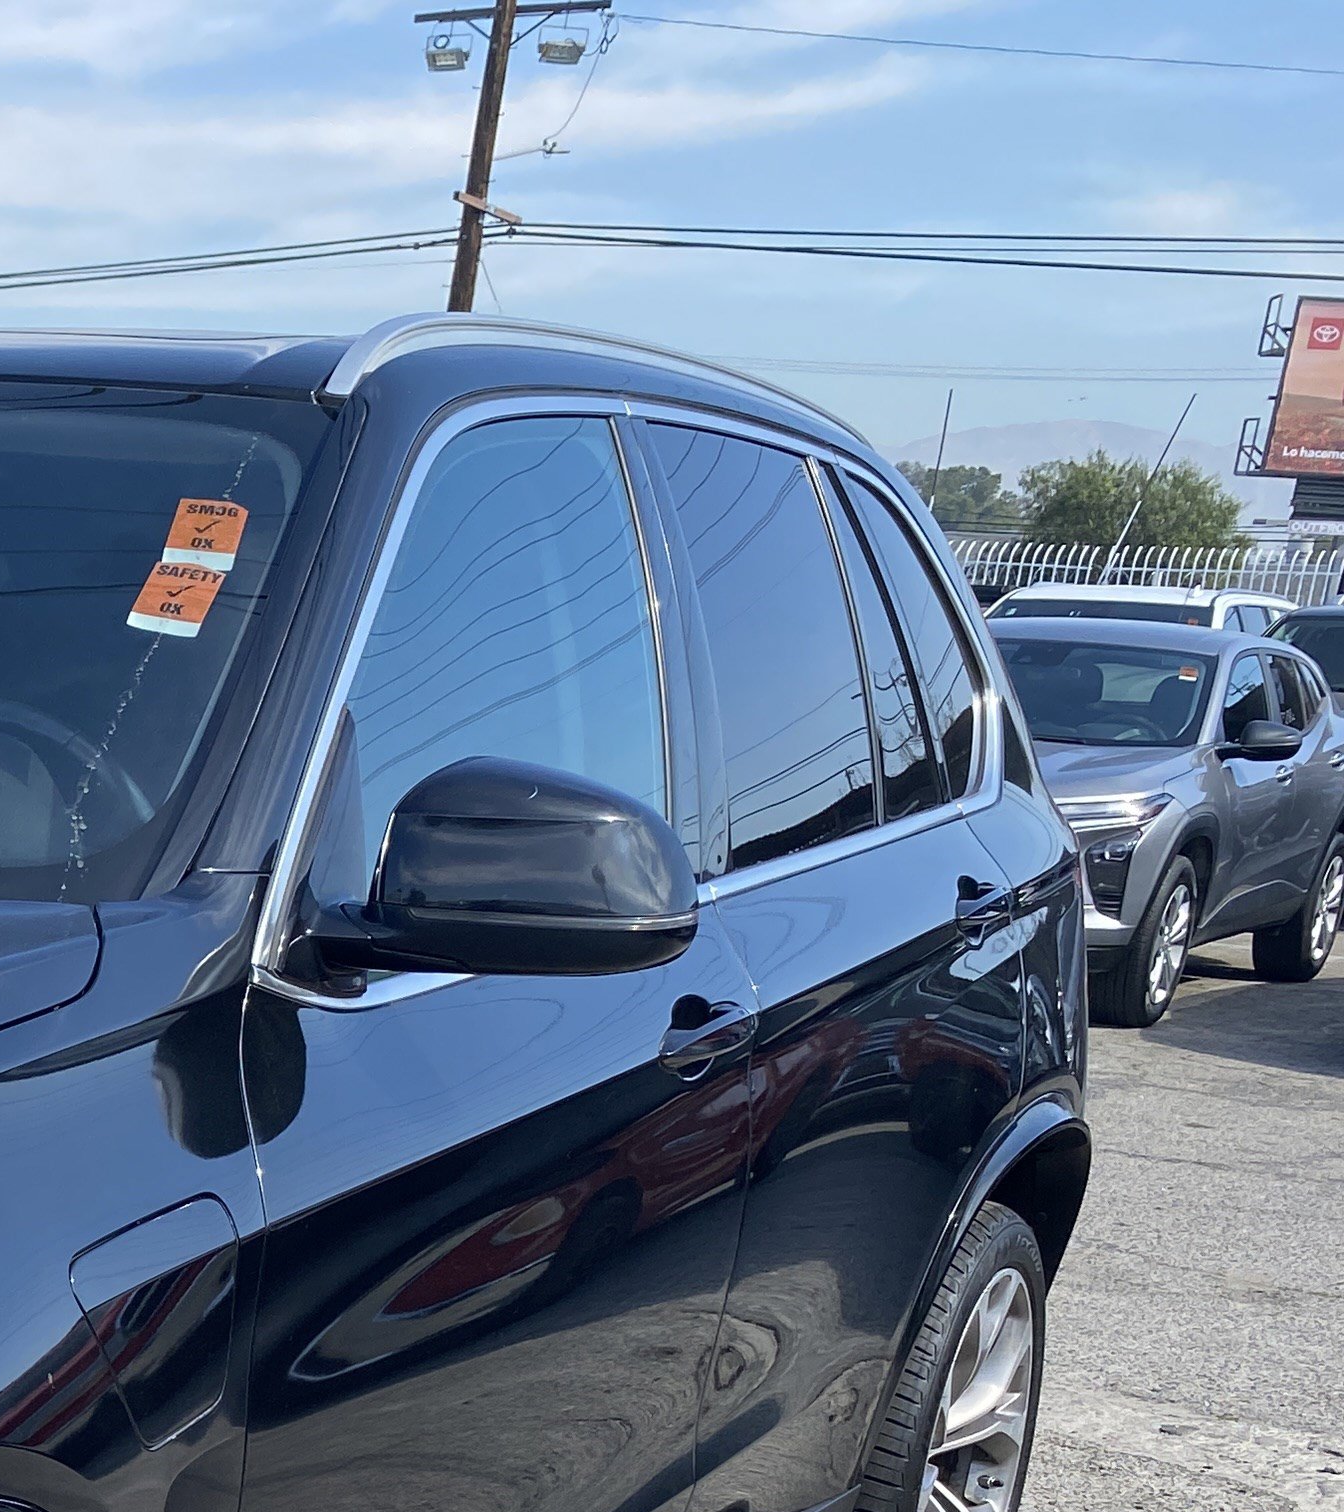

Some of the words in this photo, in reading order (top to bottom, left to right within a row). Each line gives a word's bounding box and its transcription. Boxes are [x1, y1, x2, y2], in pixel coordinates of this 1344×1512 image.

[1283, 446, 1298, 457] Lo
[186, 503, 239, 518] SMOG
[190, 537, 215, 549] OK
[156, 565, 222, 584] SAFETY
[160, 602, 185, 615] OK
